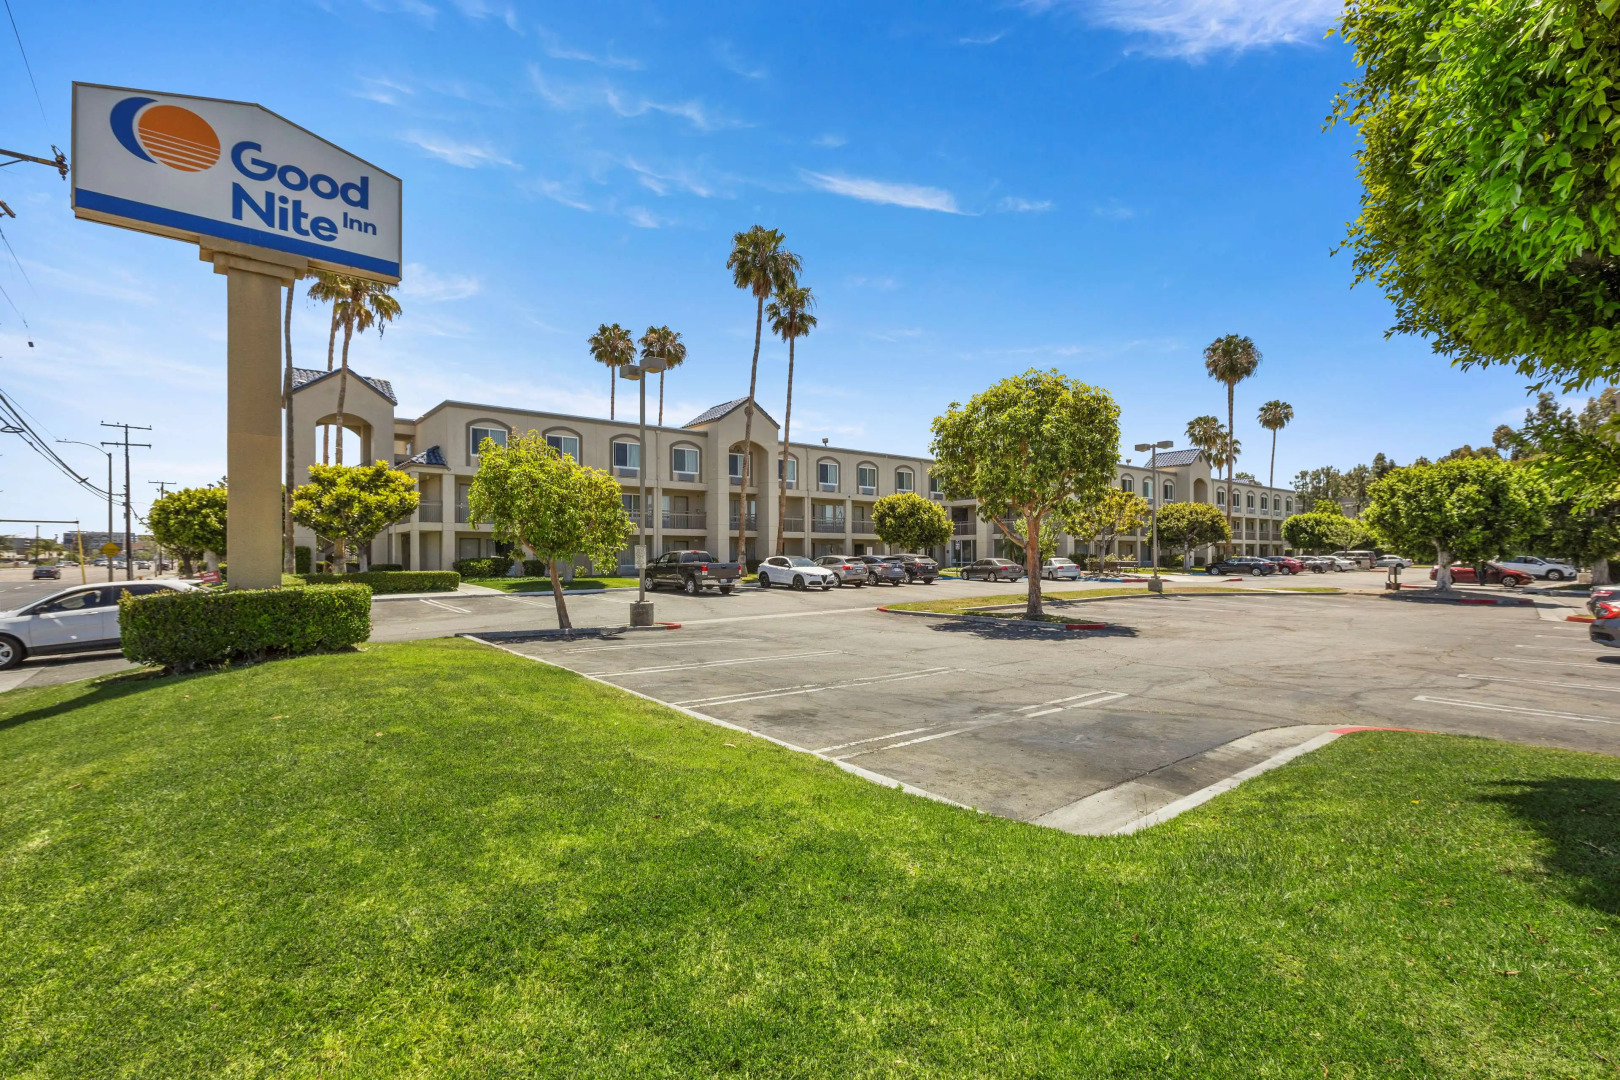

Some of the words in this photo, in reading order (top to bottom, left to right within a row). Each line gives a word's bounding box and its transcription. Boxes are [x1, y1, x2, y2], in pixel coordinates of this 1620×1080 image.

[231, 141, 369, 210] Good
[231, 182, 339, 242] Nite
[343, 211, 377, 236] Inn
